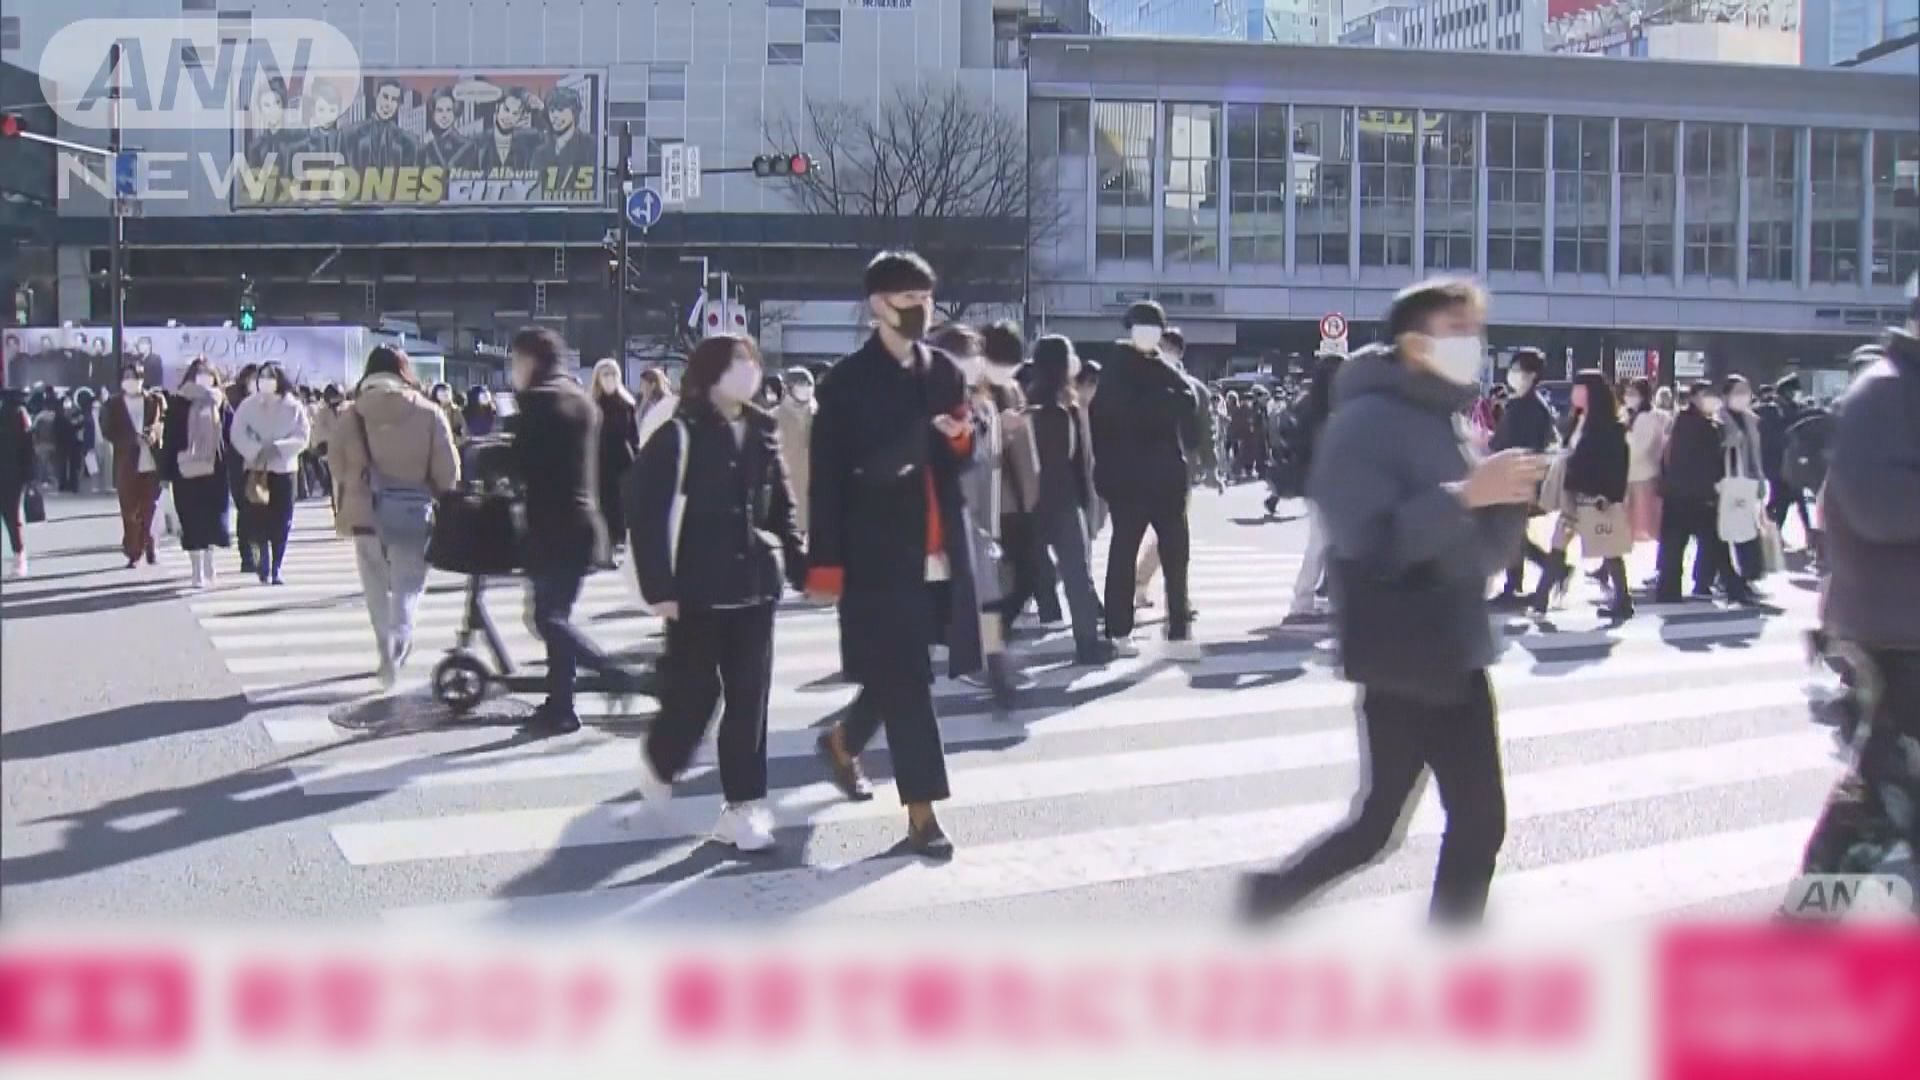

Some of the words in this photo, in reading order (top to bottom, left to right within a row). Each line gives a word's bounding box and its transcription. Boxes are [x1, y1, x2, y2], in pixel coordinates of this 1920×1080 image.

[450, 167, 484, 179] New
[487, 167, 538, 179] Album
[546, 165, 594, 190] 1/5
[449, 180, 540, 201] CITY
[1595, 524, 1612, 535] GU
